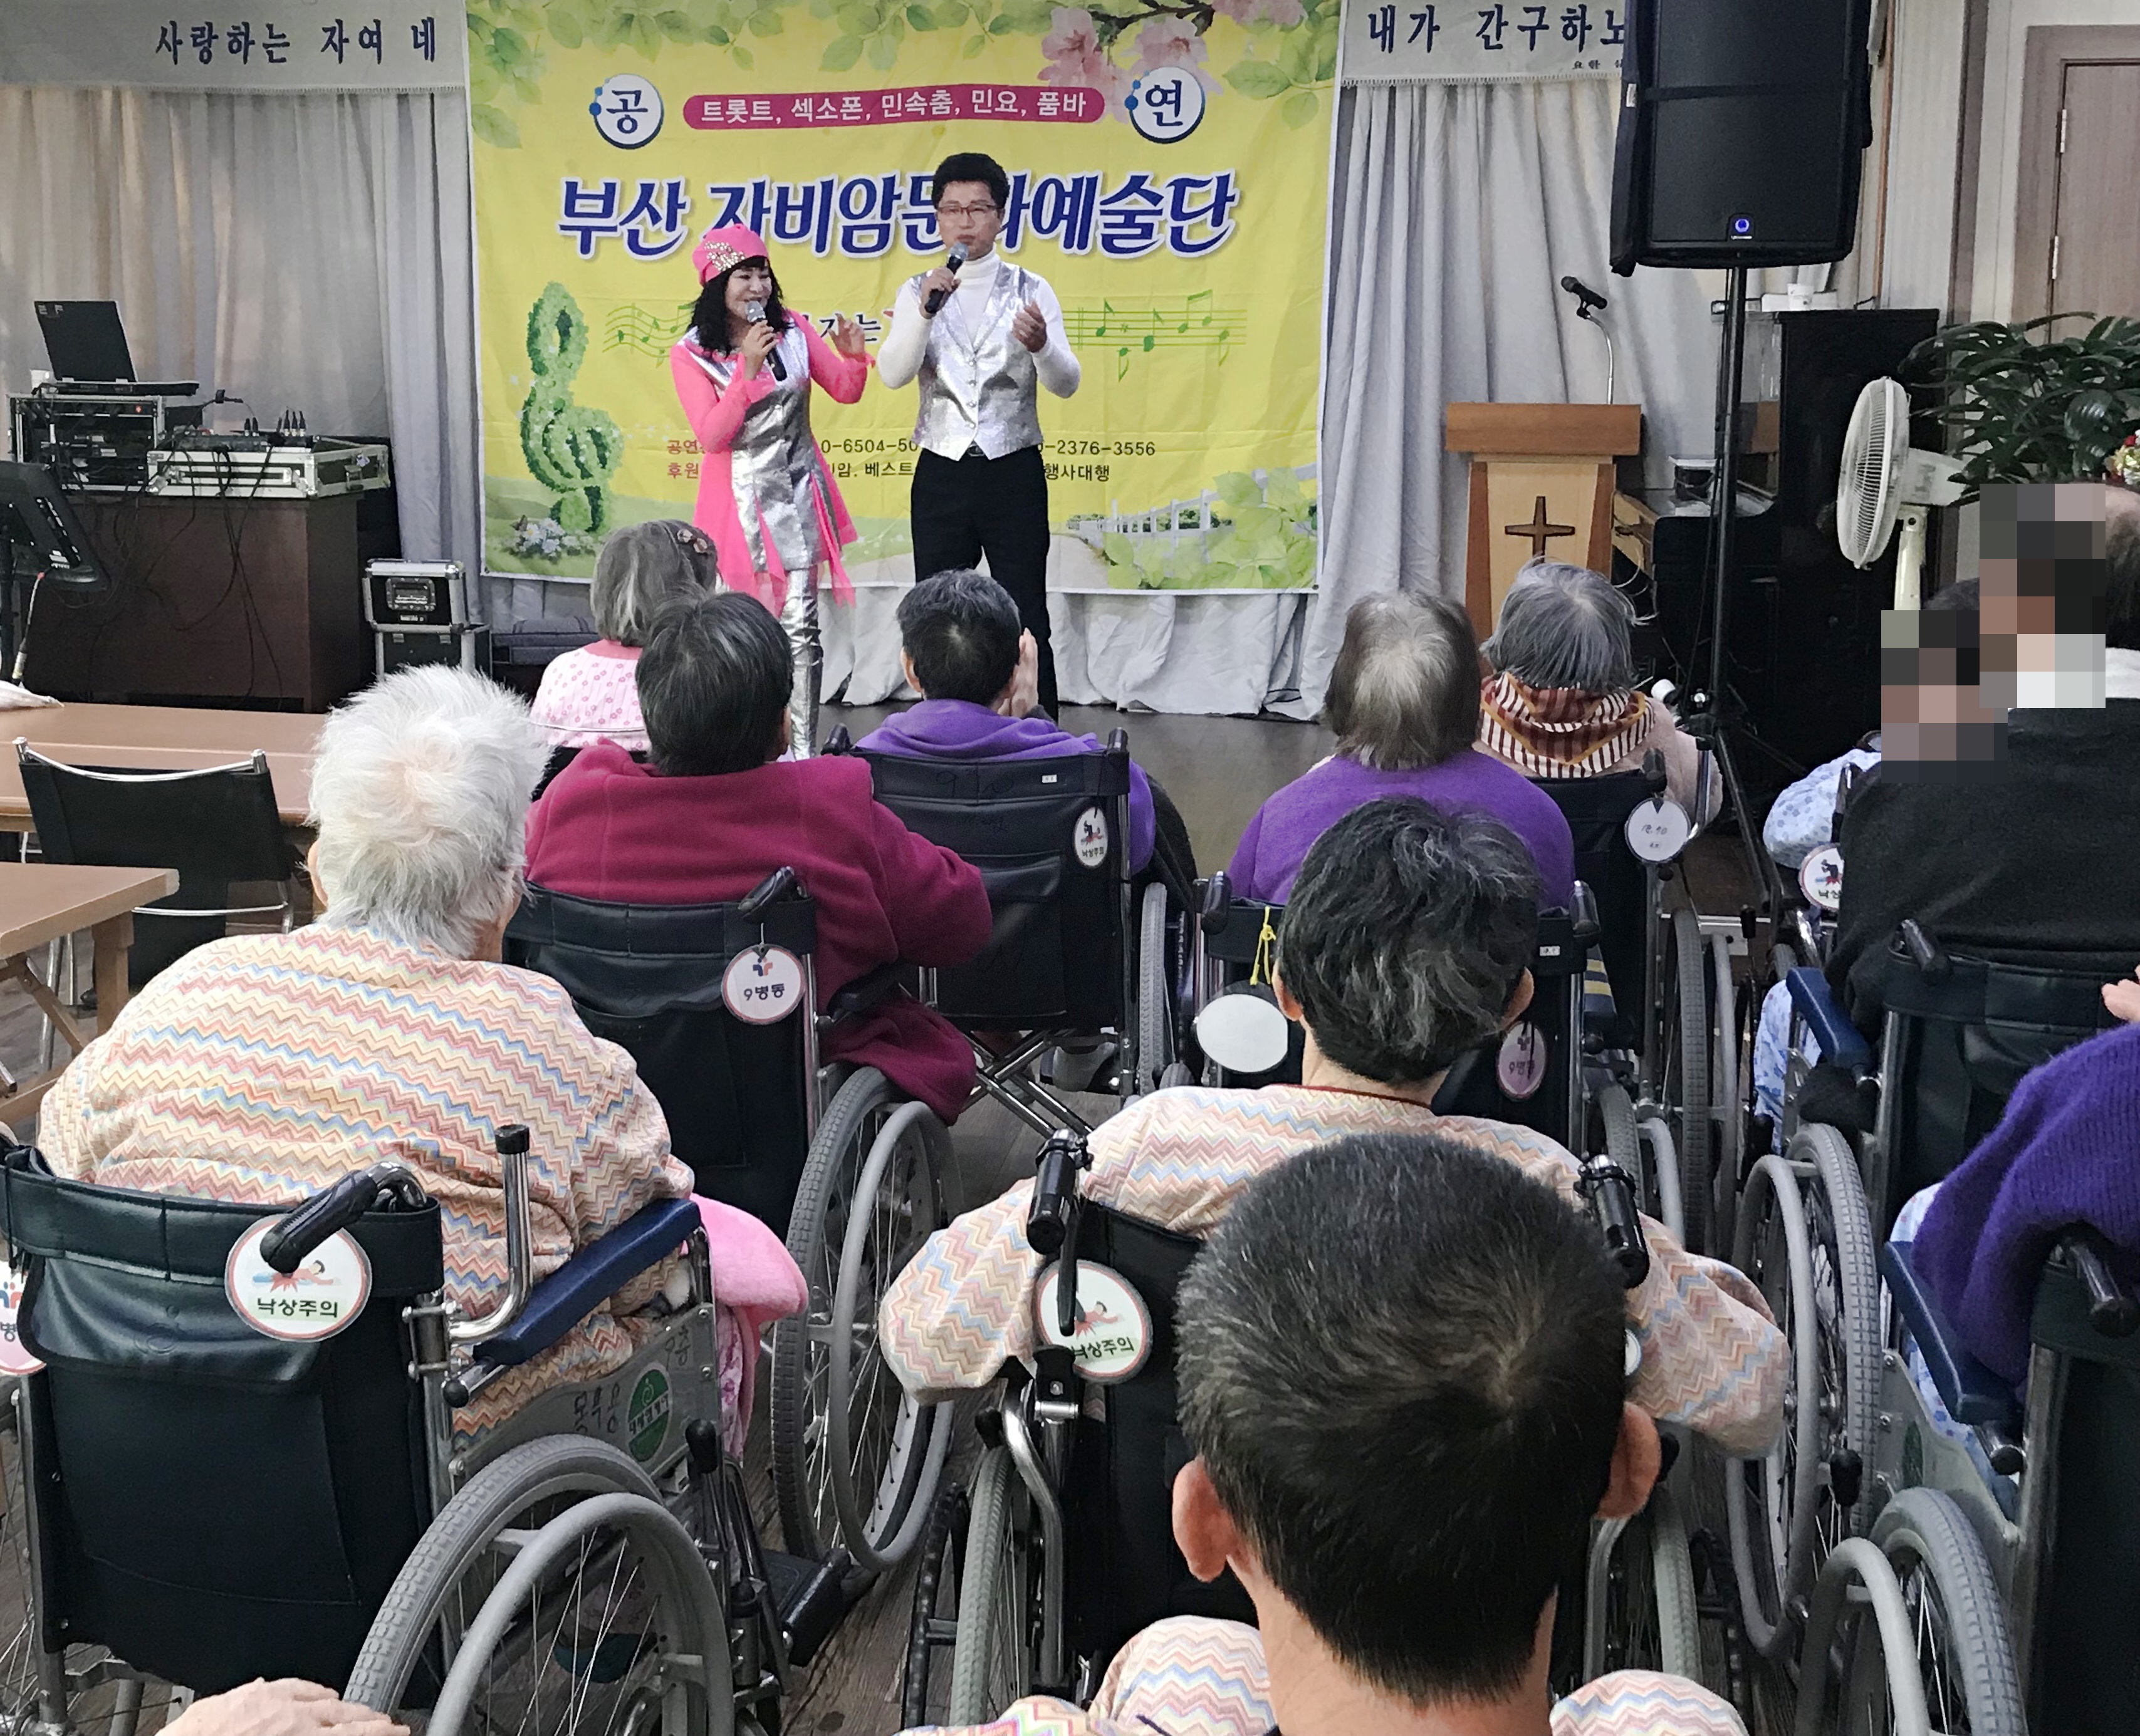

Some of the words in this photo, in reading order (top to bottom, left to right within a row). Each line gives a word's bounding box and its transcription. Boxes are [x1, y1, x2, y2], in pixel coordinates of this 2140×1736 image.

[155, 20, 291, 65] 사랑하는
[320, 18, 382, 64] 자여
[410, 16, 436, 63] 네
[1367, 4, 1441, 53] 내가
[605, 89, 649, 134] 공
[701, 98, 781, 125] 트롯트,
[791, 96, 871, 122] 섹소폰,
[881, 89, 960, 118] 민속춤,
[971, 88, 1027, 117] 민요,
[1036, 91, 1087, 117] 품바
[1144, 79, 1182, 127] 연
[558, 179, 687, 257] 부산
[666, 439, 706, 455] 공연
[864, 461, 914, 477] 베스트
[1044, 463, 1110, 482] 행사대행
[743, 983, 785, 1001] 9병동
[257, 1297, 338, 1318] 낙상주의
